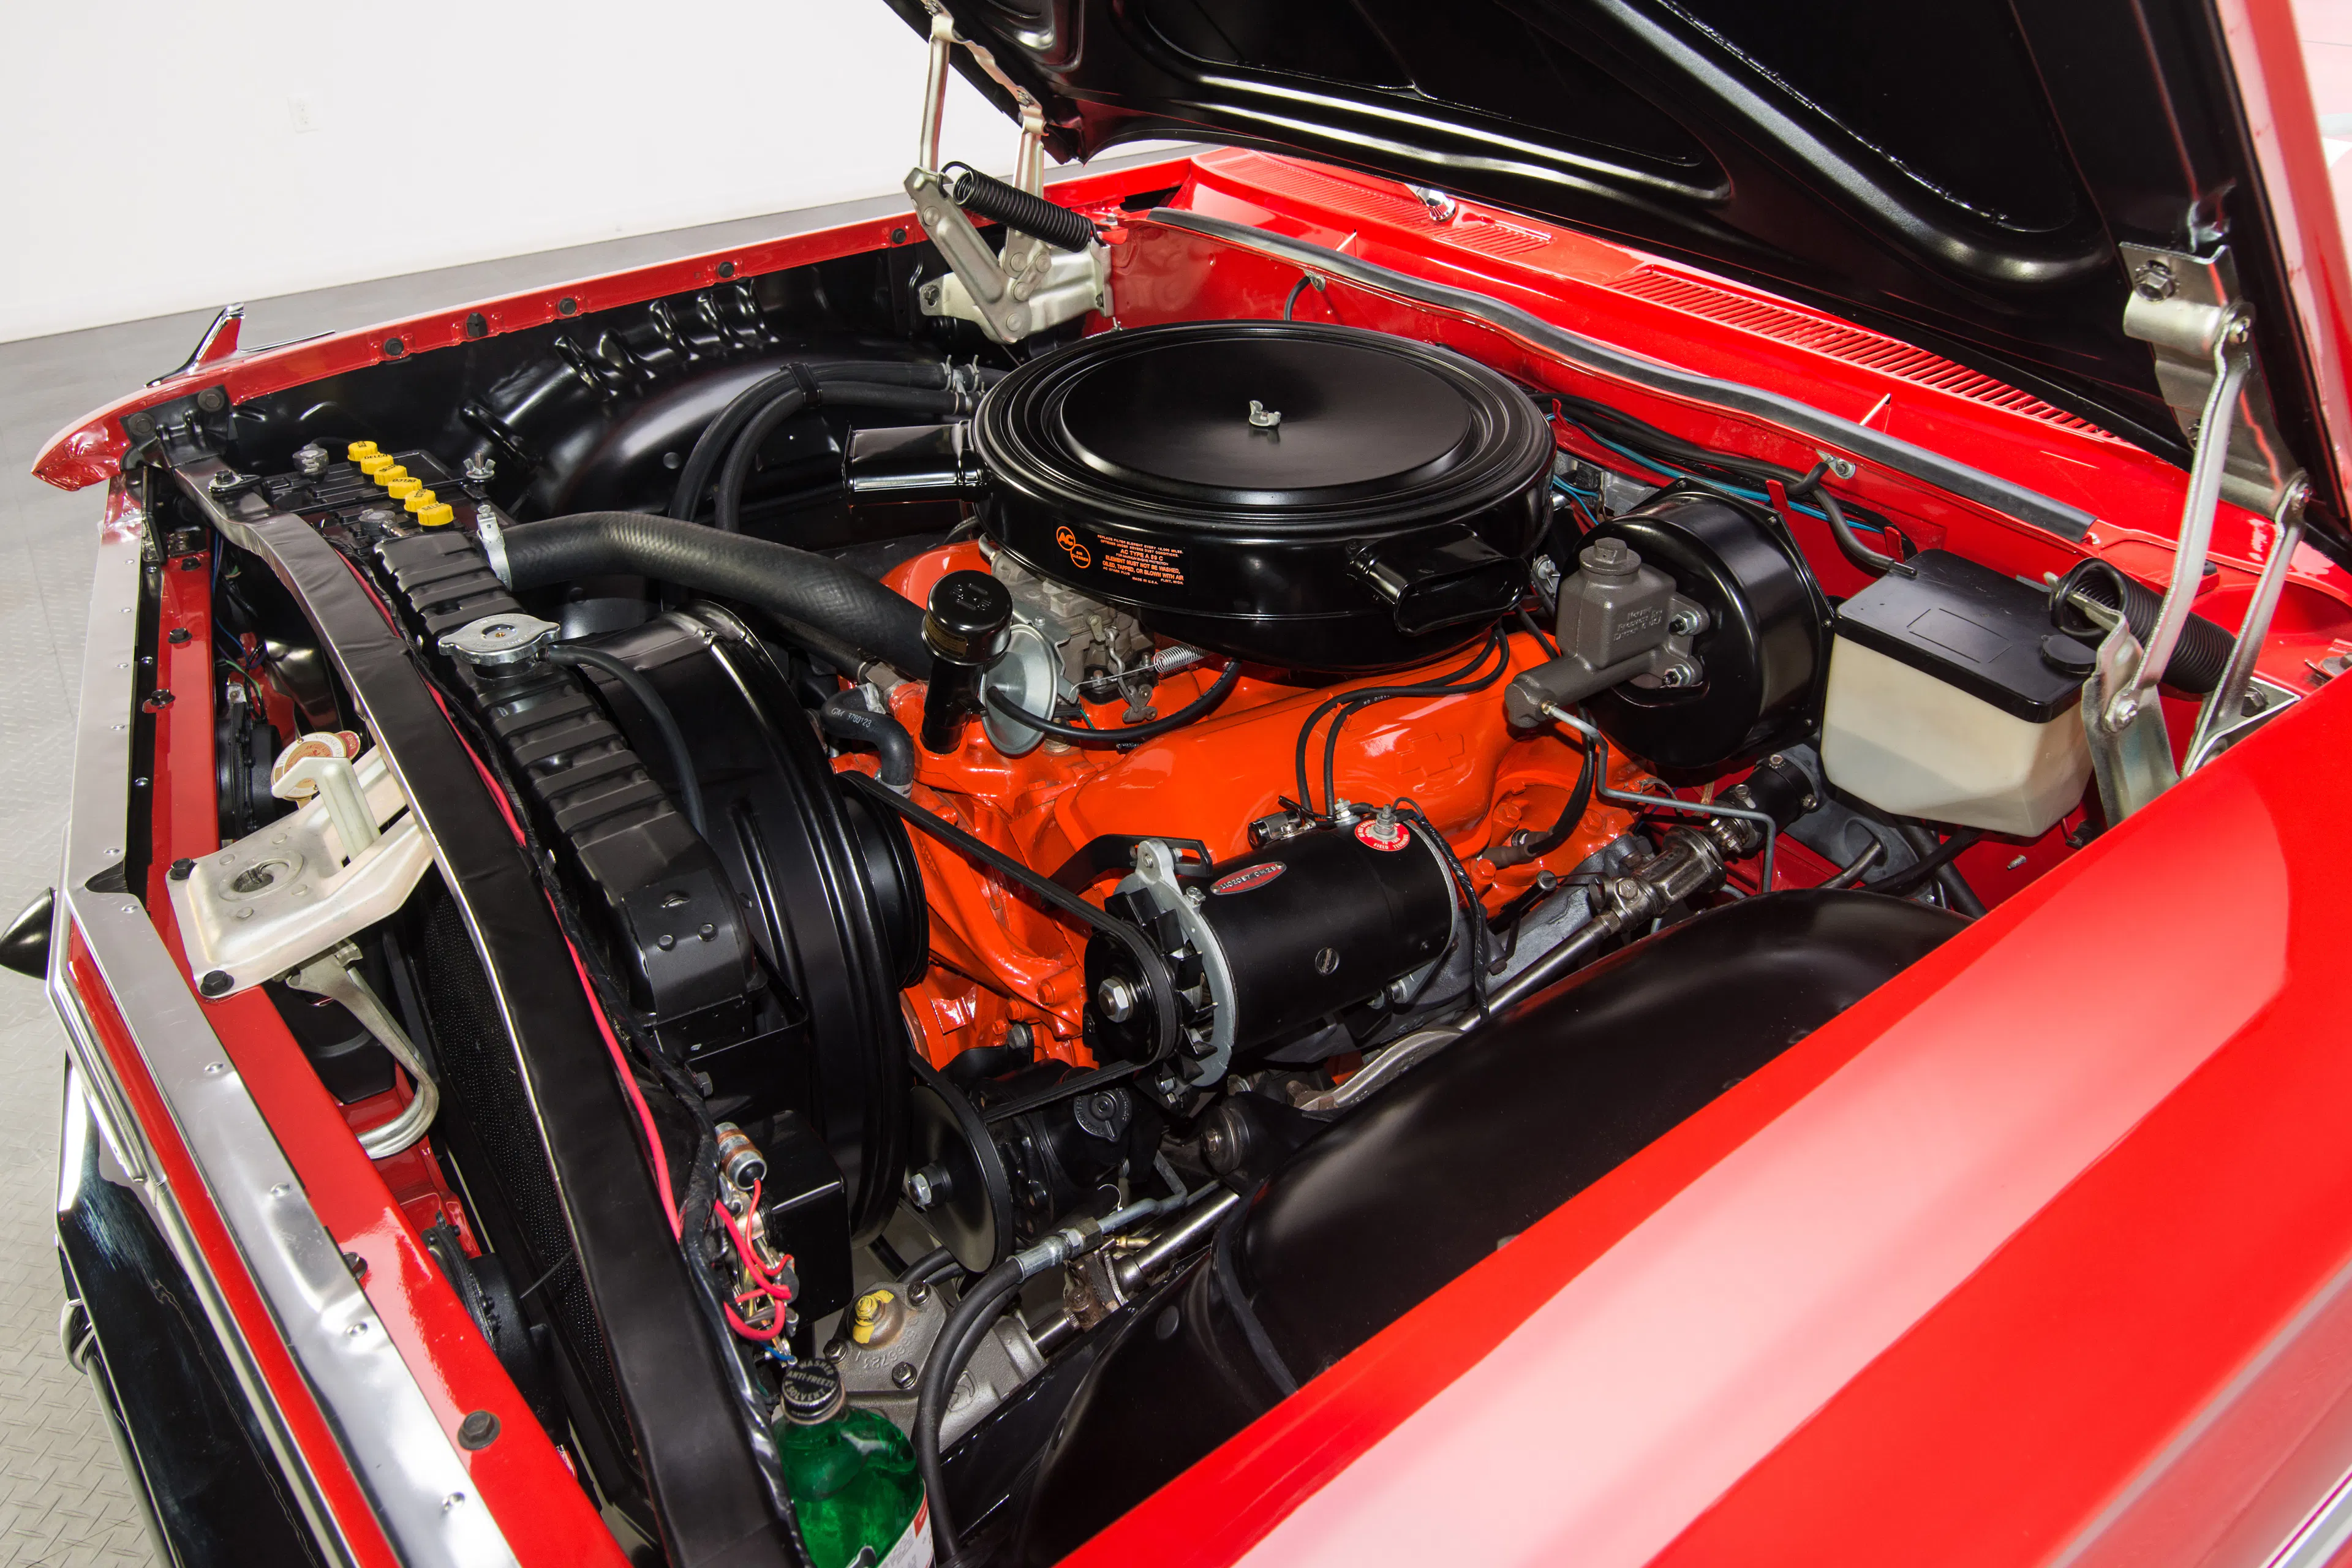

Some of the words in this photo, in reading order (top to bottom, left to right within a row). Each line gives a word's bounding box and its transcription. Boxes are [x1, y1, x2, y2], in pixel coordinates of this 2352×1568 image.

[1059, 532, 1074, 546] AC
[1105, 554, 1126, 564] ELEMENT
[1159, 566, 1180, 575] WASHED,
[1117, 564, 1136, 573] TAPPED,
[1144, 569, 1162, 578] BLOWN
[831, 707, 846, 717] GM
[846, 712, 872, 728] 3760123
[346, 734, 356, 749] SENIOR
[1392, 834, 1409, 850] TERMINAL
[798, 1359, 835, 1376] WASHER
[786, 1370, 835, 1388] ANTI-FREEZE
[786, 1385, 826, 1401] SOLVENT
